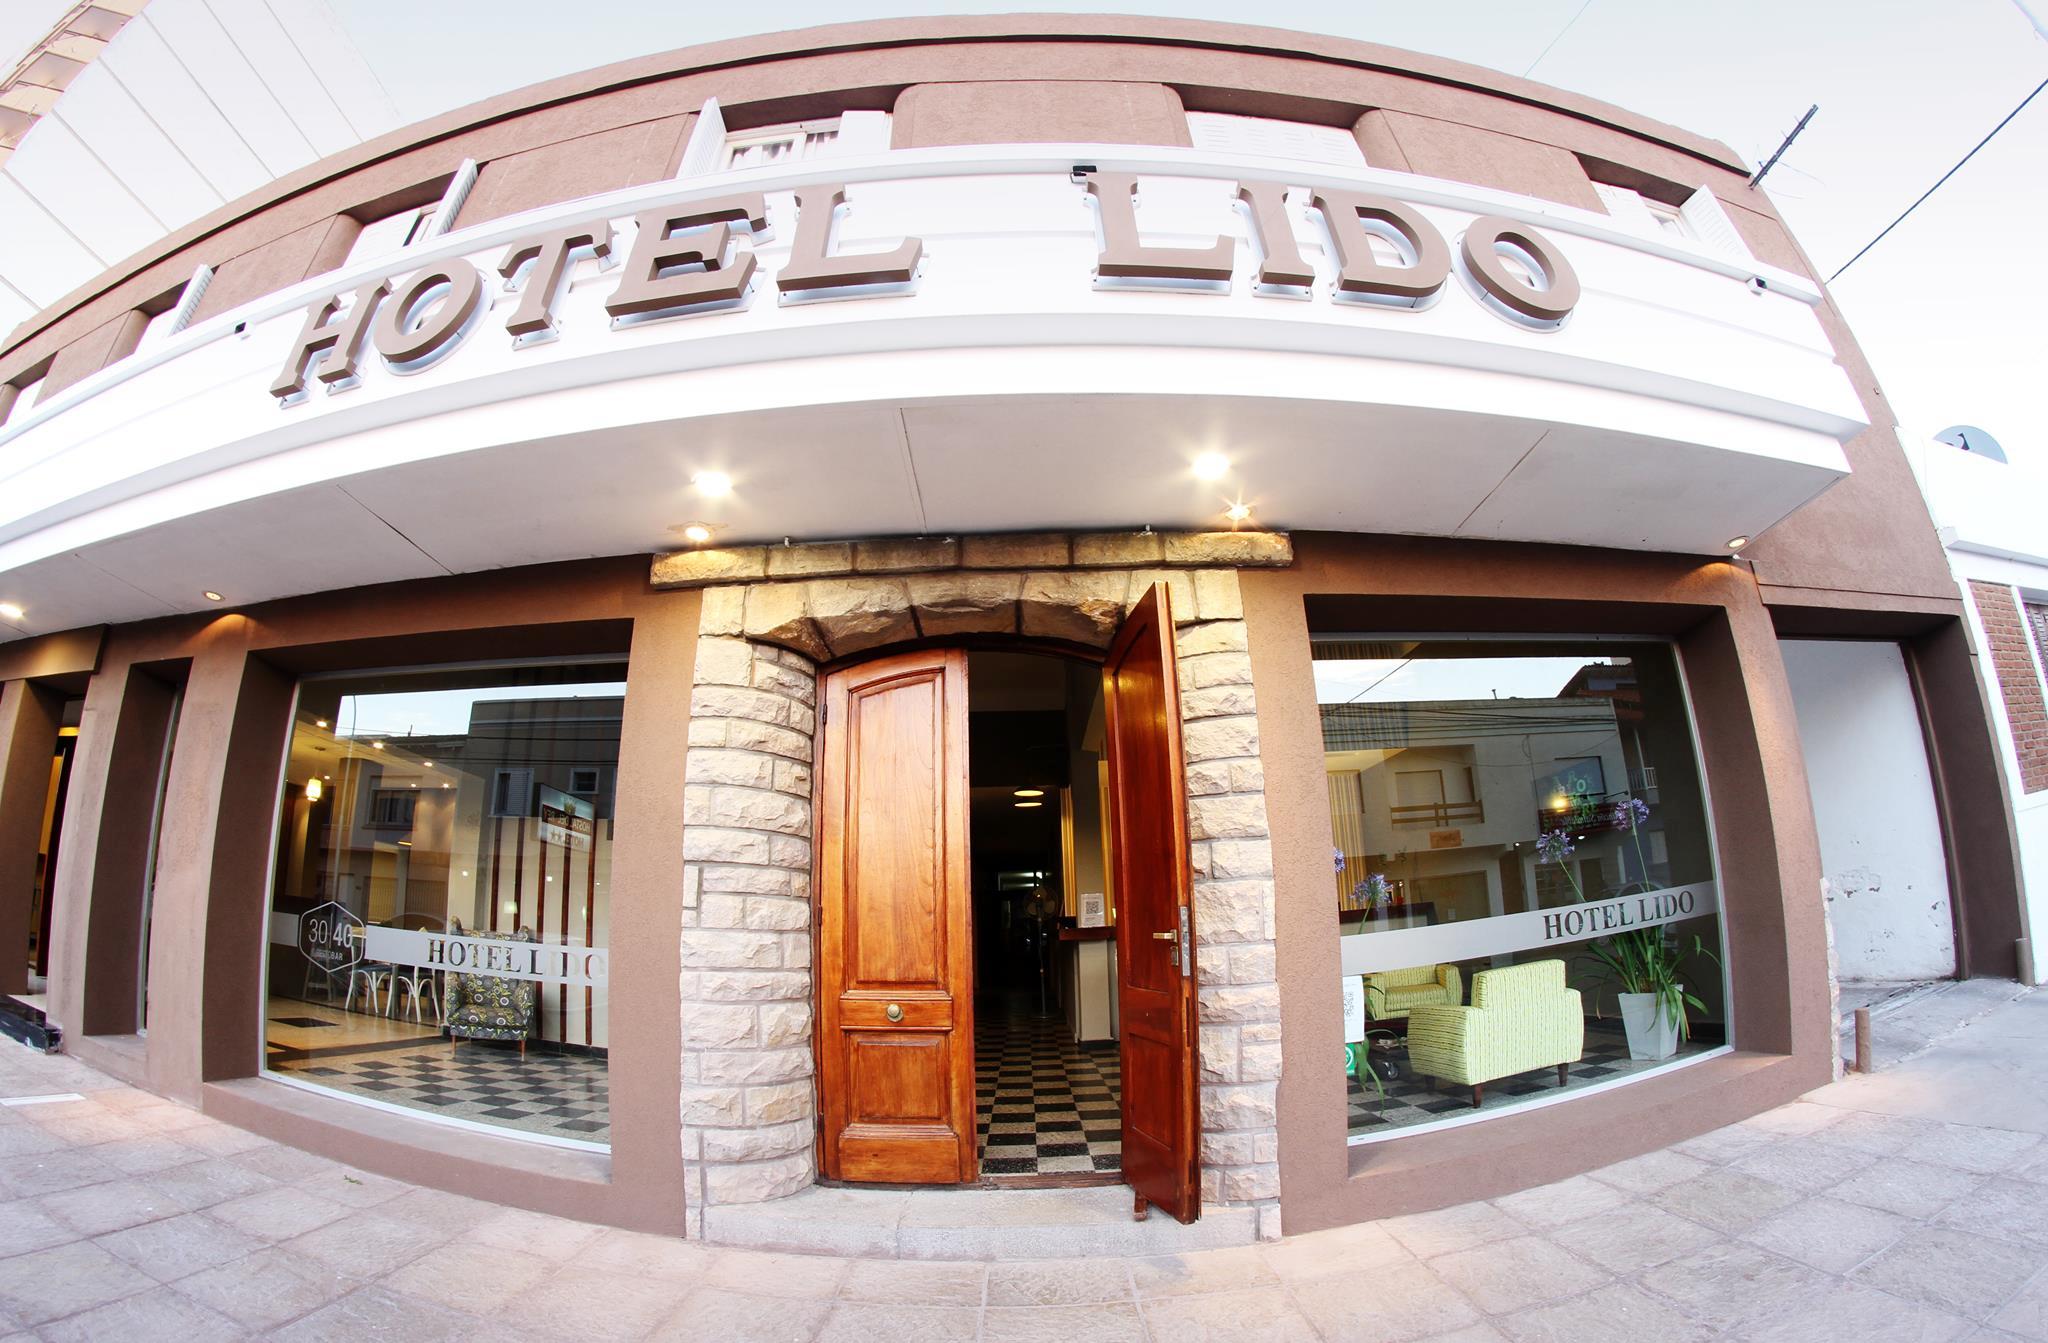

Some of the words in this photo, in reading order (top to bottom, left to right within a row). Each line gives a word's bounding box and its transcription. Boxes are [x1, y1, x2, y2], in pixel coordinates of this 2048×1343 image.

[270, 184, 926, 403] HOTEL
[1085, 172, 1582, 326] LIDO
[1542, 901, 1634, 940] HOTEL
[1637, 889, 1695, 924] LIDO
[427, 937, 522, 973] HOTEL
[528, 948, 606, 981] LIDO
